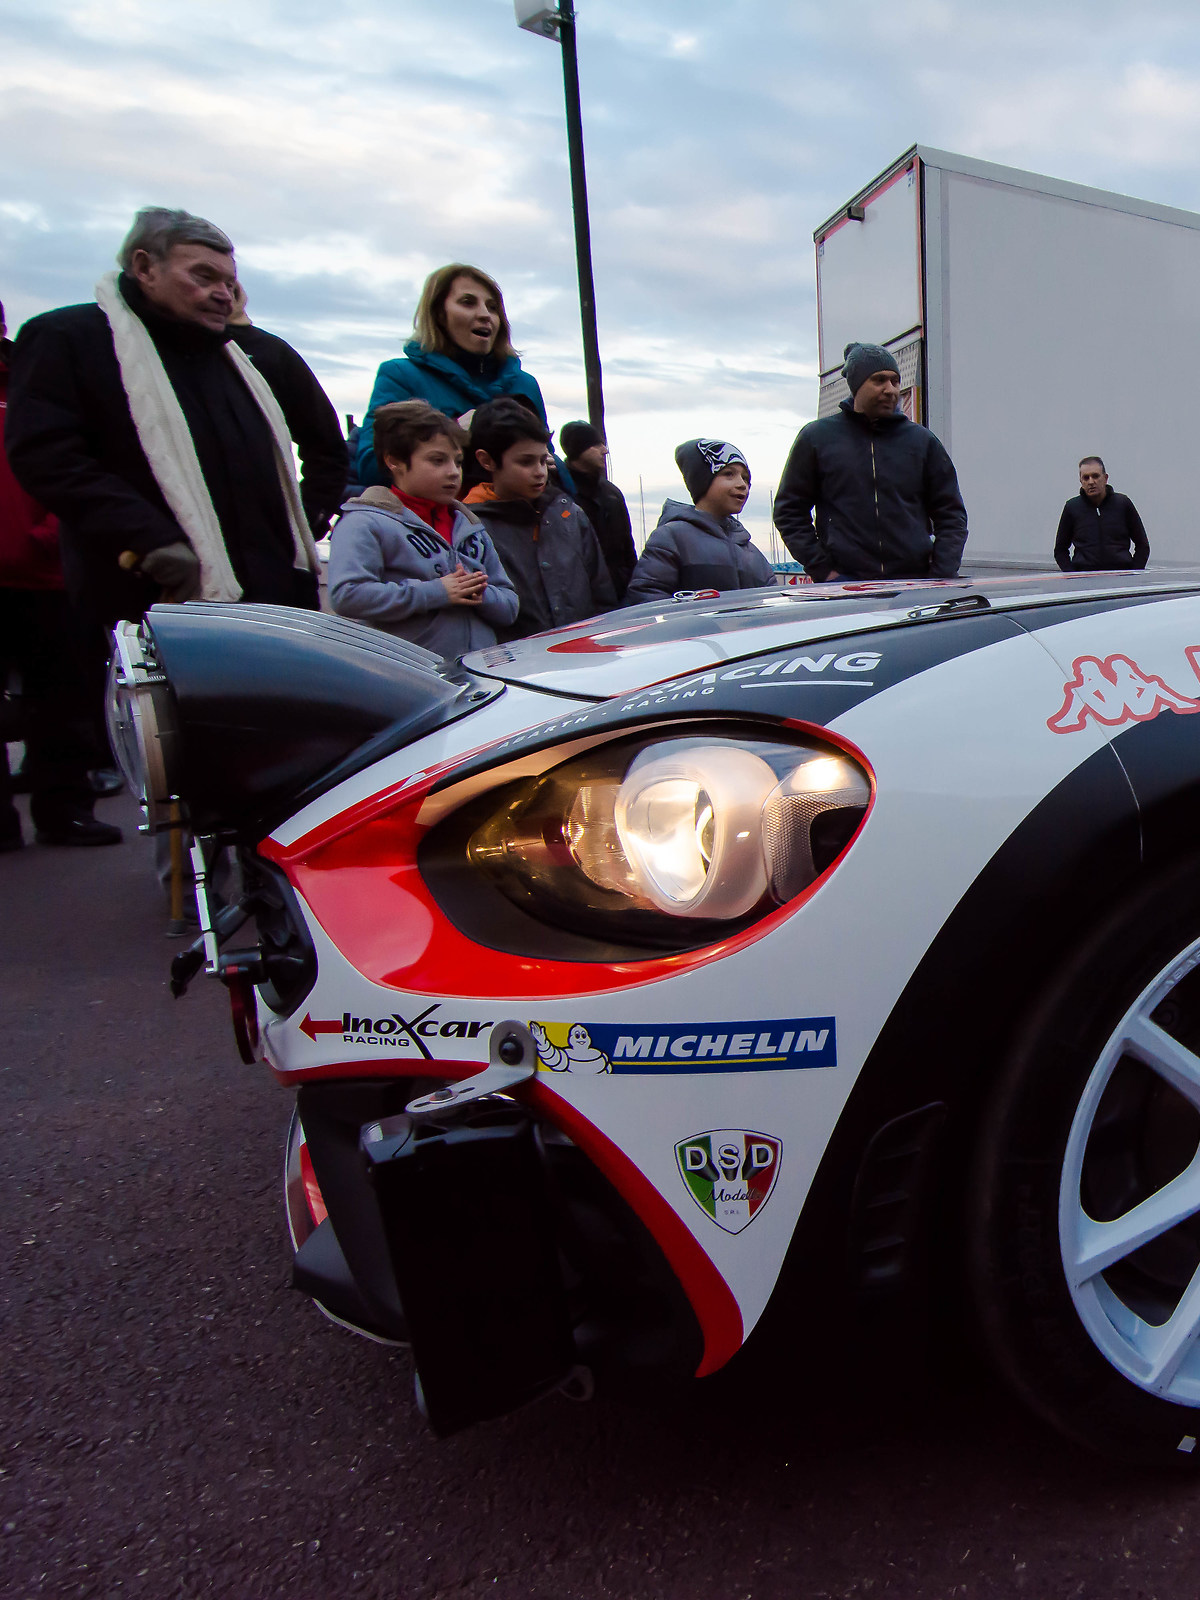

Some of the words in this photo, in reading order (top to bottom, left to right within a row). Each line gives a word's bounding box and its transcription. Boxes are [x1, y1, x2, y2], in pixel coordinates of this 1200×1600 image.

[620, 686, 715, 712] RACING
[343, 1034, 410, 1047] RACING
[612, 1029, 830, 1058] MICHELIN
[685, 1143, 774, 1172] DSD
